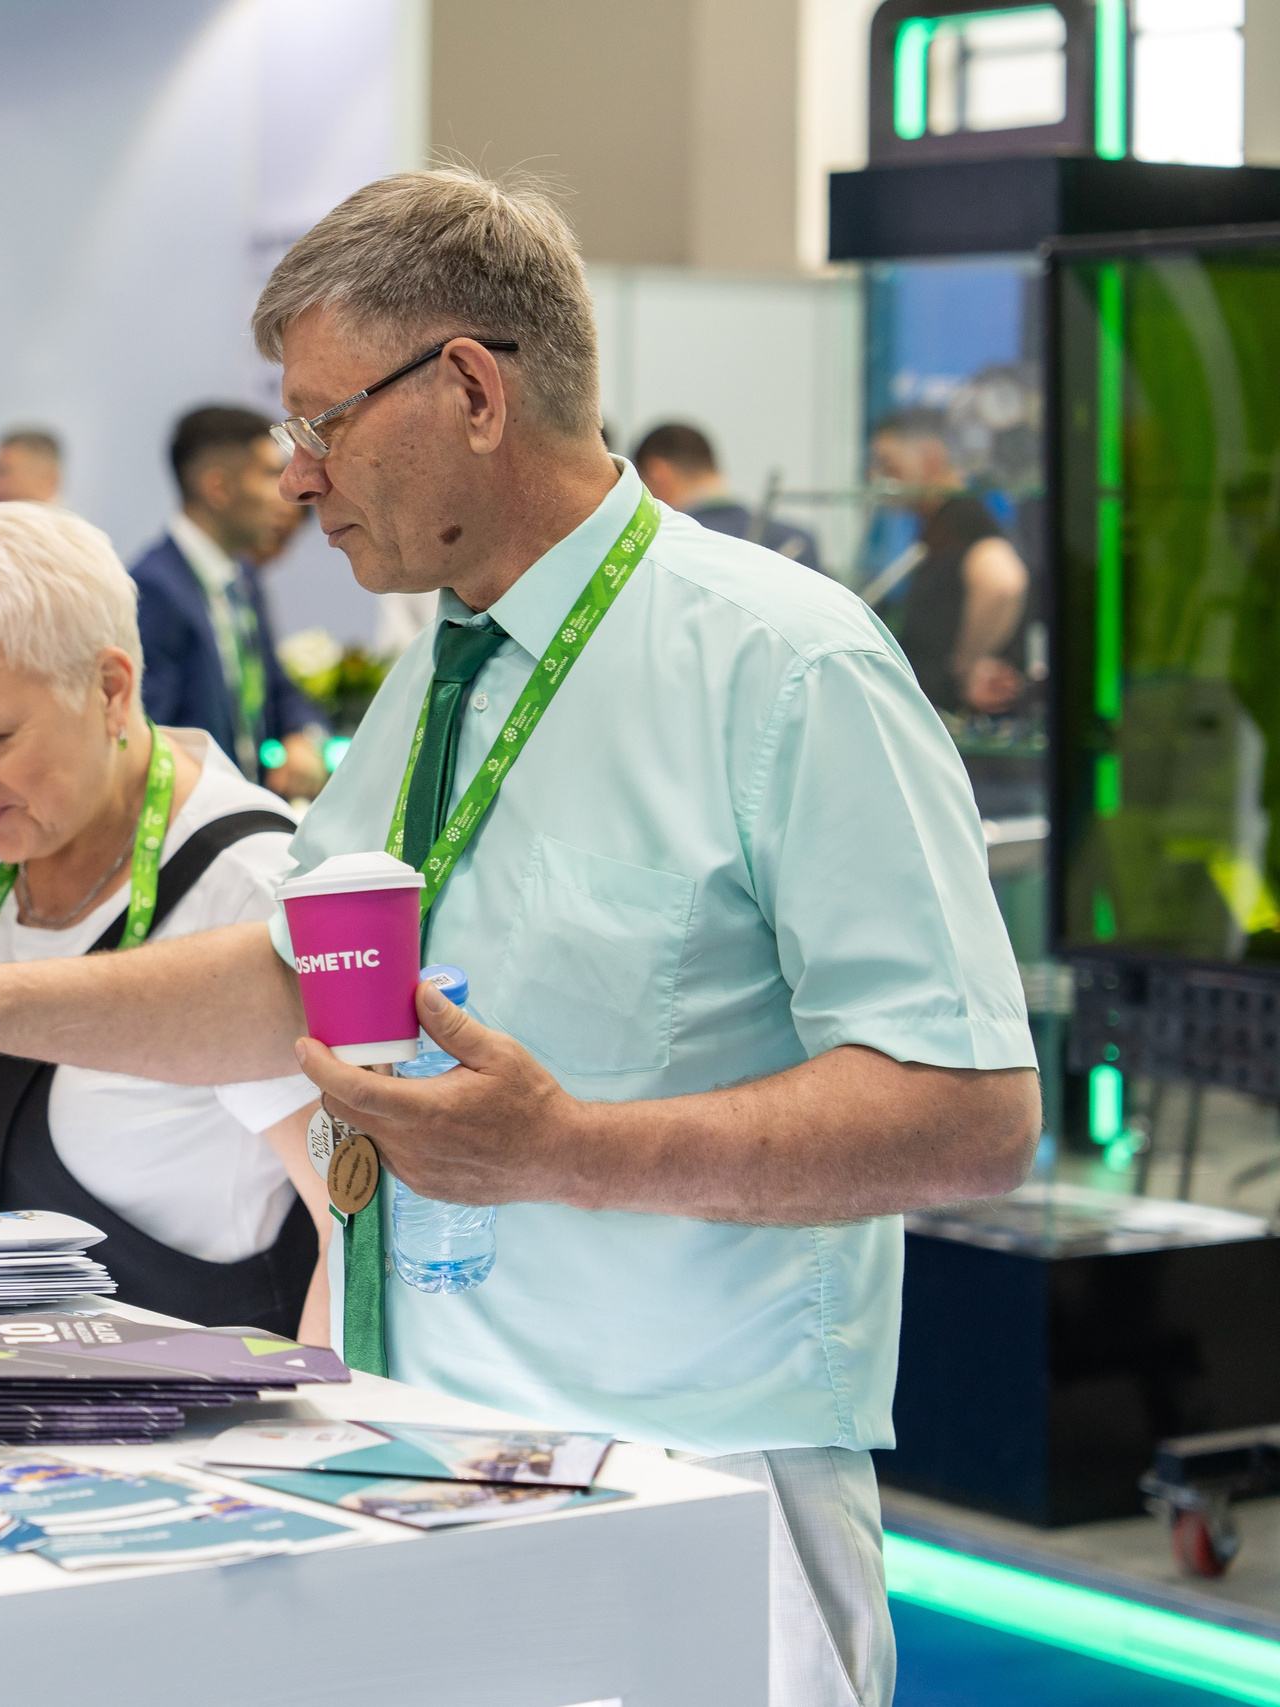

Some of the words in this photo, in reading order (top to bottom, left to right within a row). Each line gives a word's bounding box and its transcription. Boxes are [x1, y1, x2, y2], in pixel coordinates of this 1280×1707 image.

[610, 564, 629, 589] INNOPROM
[549, 656, 569, 684] INNOPROM
[514, 702, 531, 727] INDUSTRIAL
[518, 715, 528, 728] WEEK
[491, 755, 510, 784] INNOPROM
[457, 801, 474, 827] INDUSTRIAL
[460, 815, 470, 829] WEEK
[433, 855, 452, 884] INNOPROM
[310, 1128, 324, 1160] 2024
